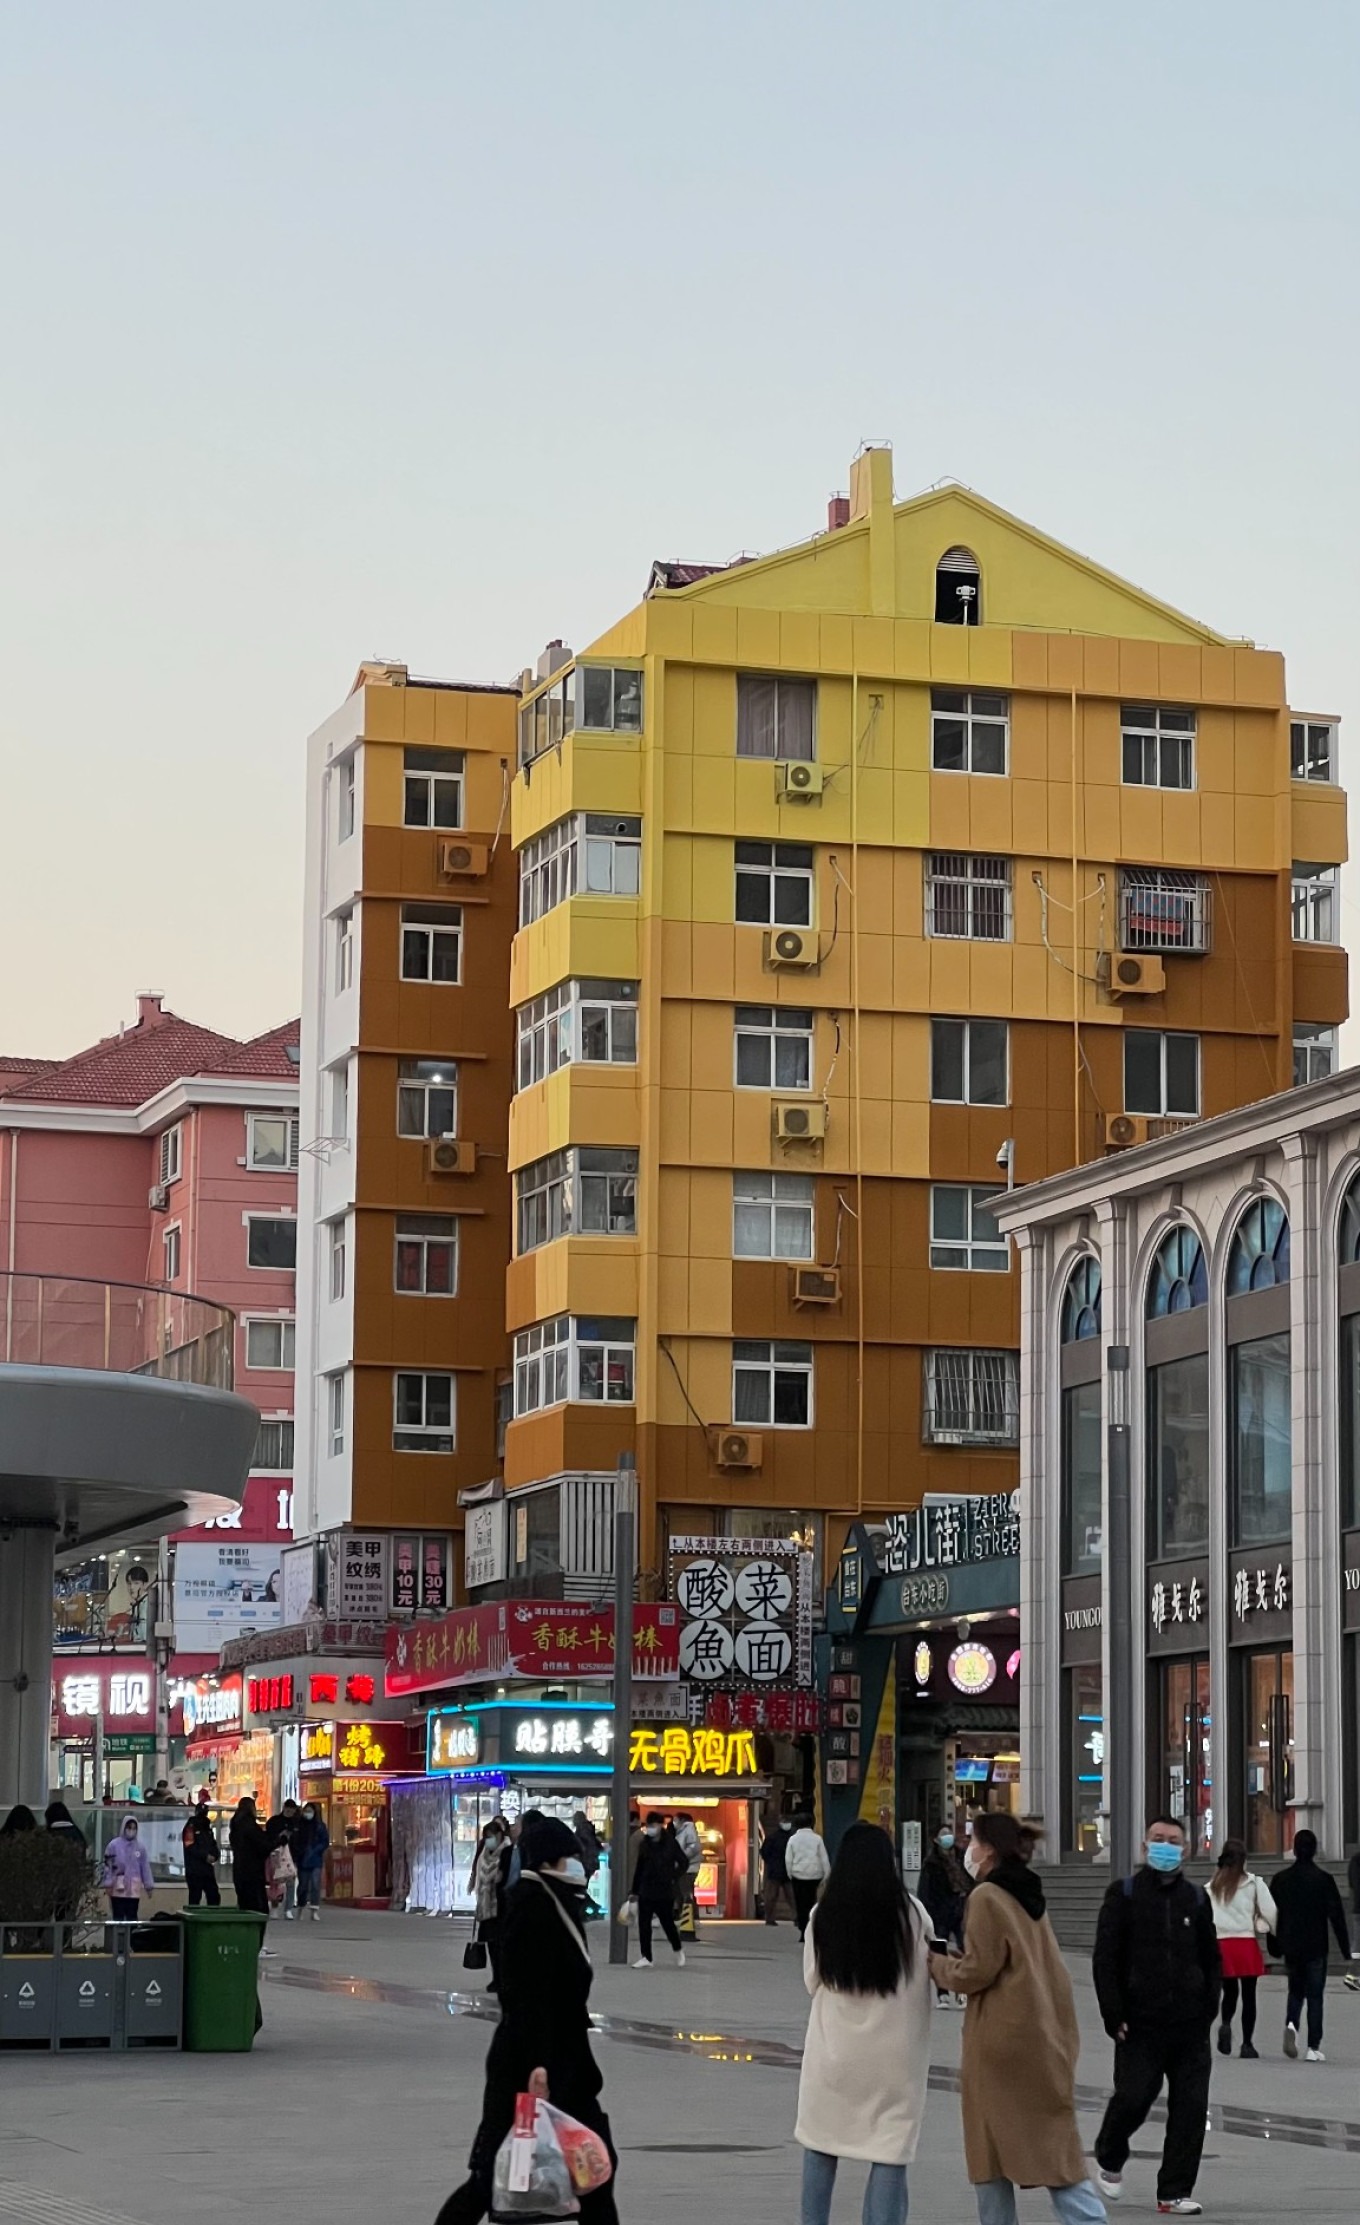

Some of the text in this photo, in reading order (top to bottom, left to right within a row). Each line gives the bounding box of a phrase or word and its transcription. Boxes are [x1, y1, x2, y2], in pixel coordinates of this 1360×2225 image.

[346, 1541, 380, 1557] 美甲
[974, 1527, 1019, 1557] STREE
[346, 1562, 381, 1578] 纹绣
[684, 1561, 788, 1620] 酸菜
[1151, 1576, 1202, 1634] 雅戈尔
[1234, 1563, 1288, 1623] 雅戈尔
[346, 1725, 371, 1749] 烤
[515, 1718, 615, 1756] 贴膜哥
[628, 1728, 758, 1776] 无骨鸡爪
